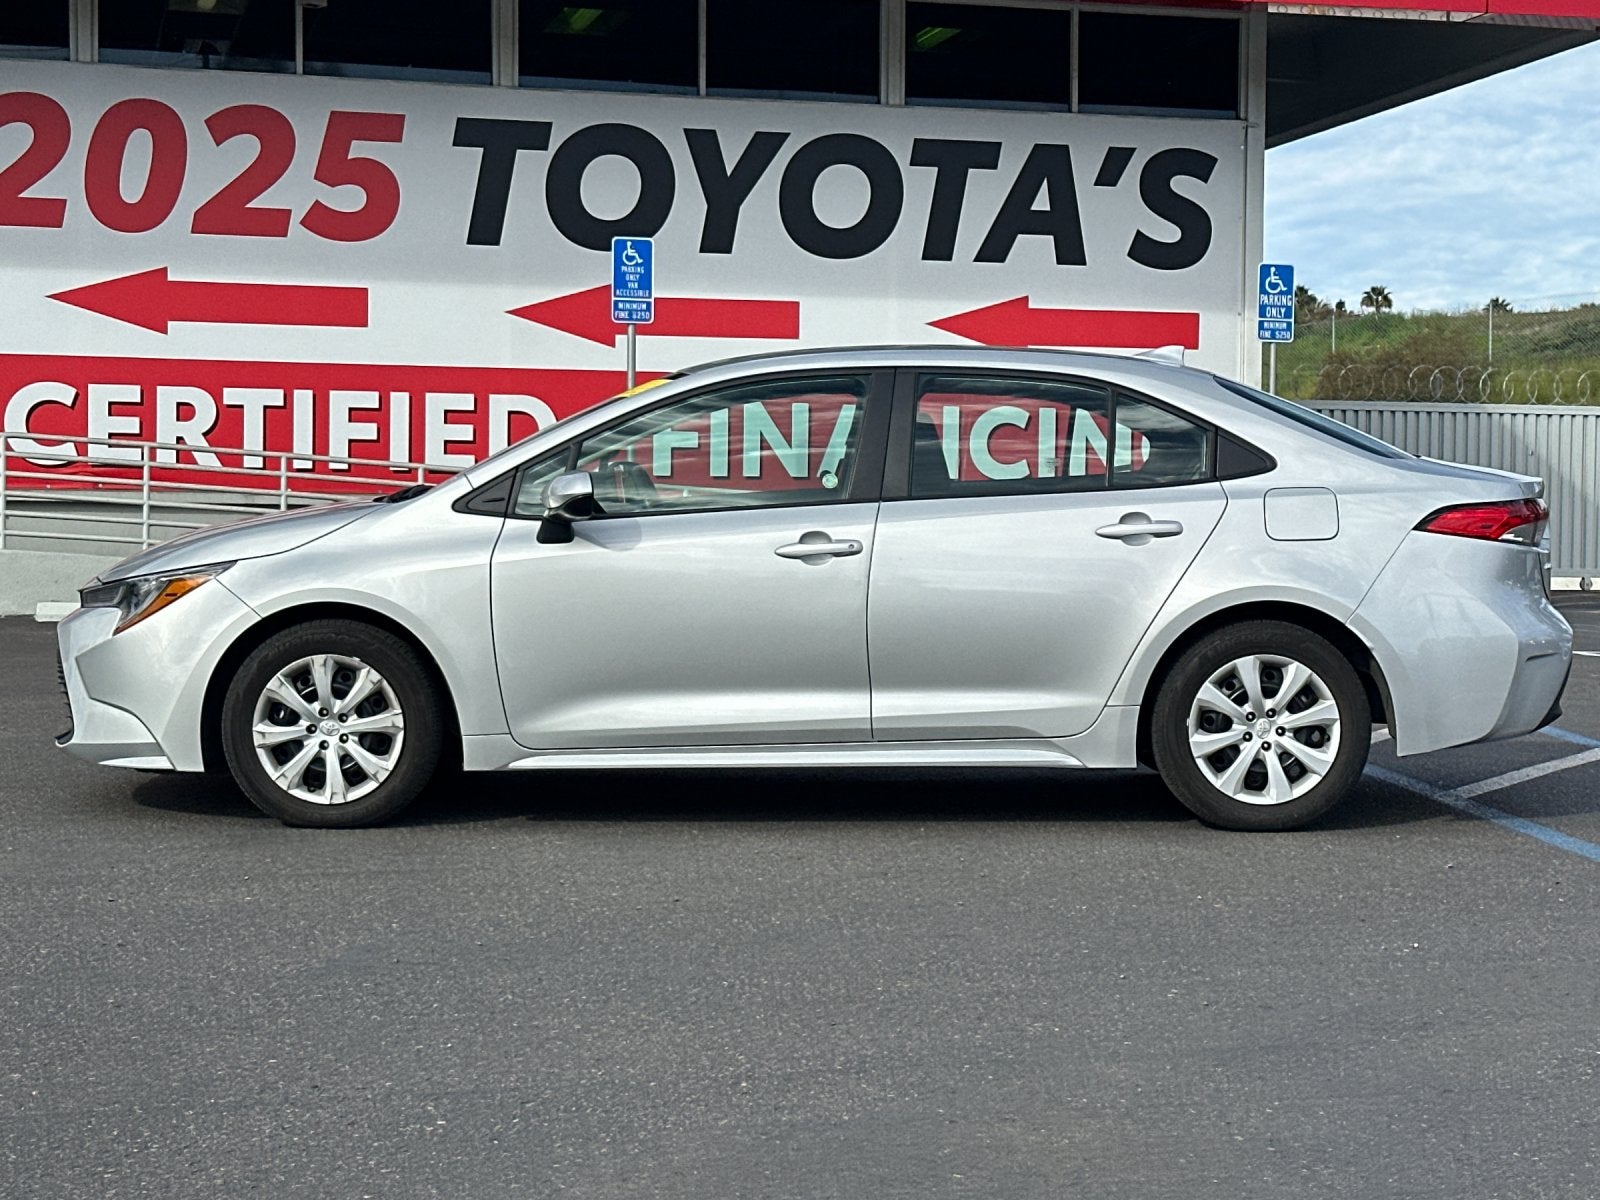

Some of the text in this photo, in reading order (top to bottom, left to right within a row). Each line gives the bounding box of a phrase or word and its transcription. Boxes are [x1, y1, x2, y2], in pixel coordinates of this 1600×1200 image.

[0, 91, 1219, 271] 2025 TOYOTA'S
[616, 289, 649, 297] ACCESSIBLE
[1260, 294, 1292, 307] PARKING
[618, 302, 647, 310] MINIMUM
[614, 310, 650, 320] FINE $250
[1265, 306, 1286, 318] ONLY
[1263, 321, 1287, 330] MINIMUM
[1259, 329, 1291, 339] FINE $250
